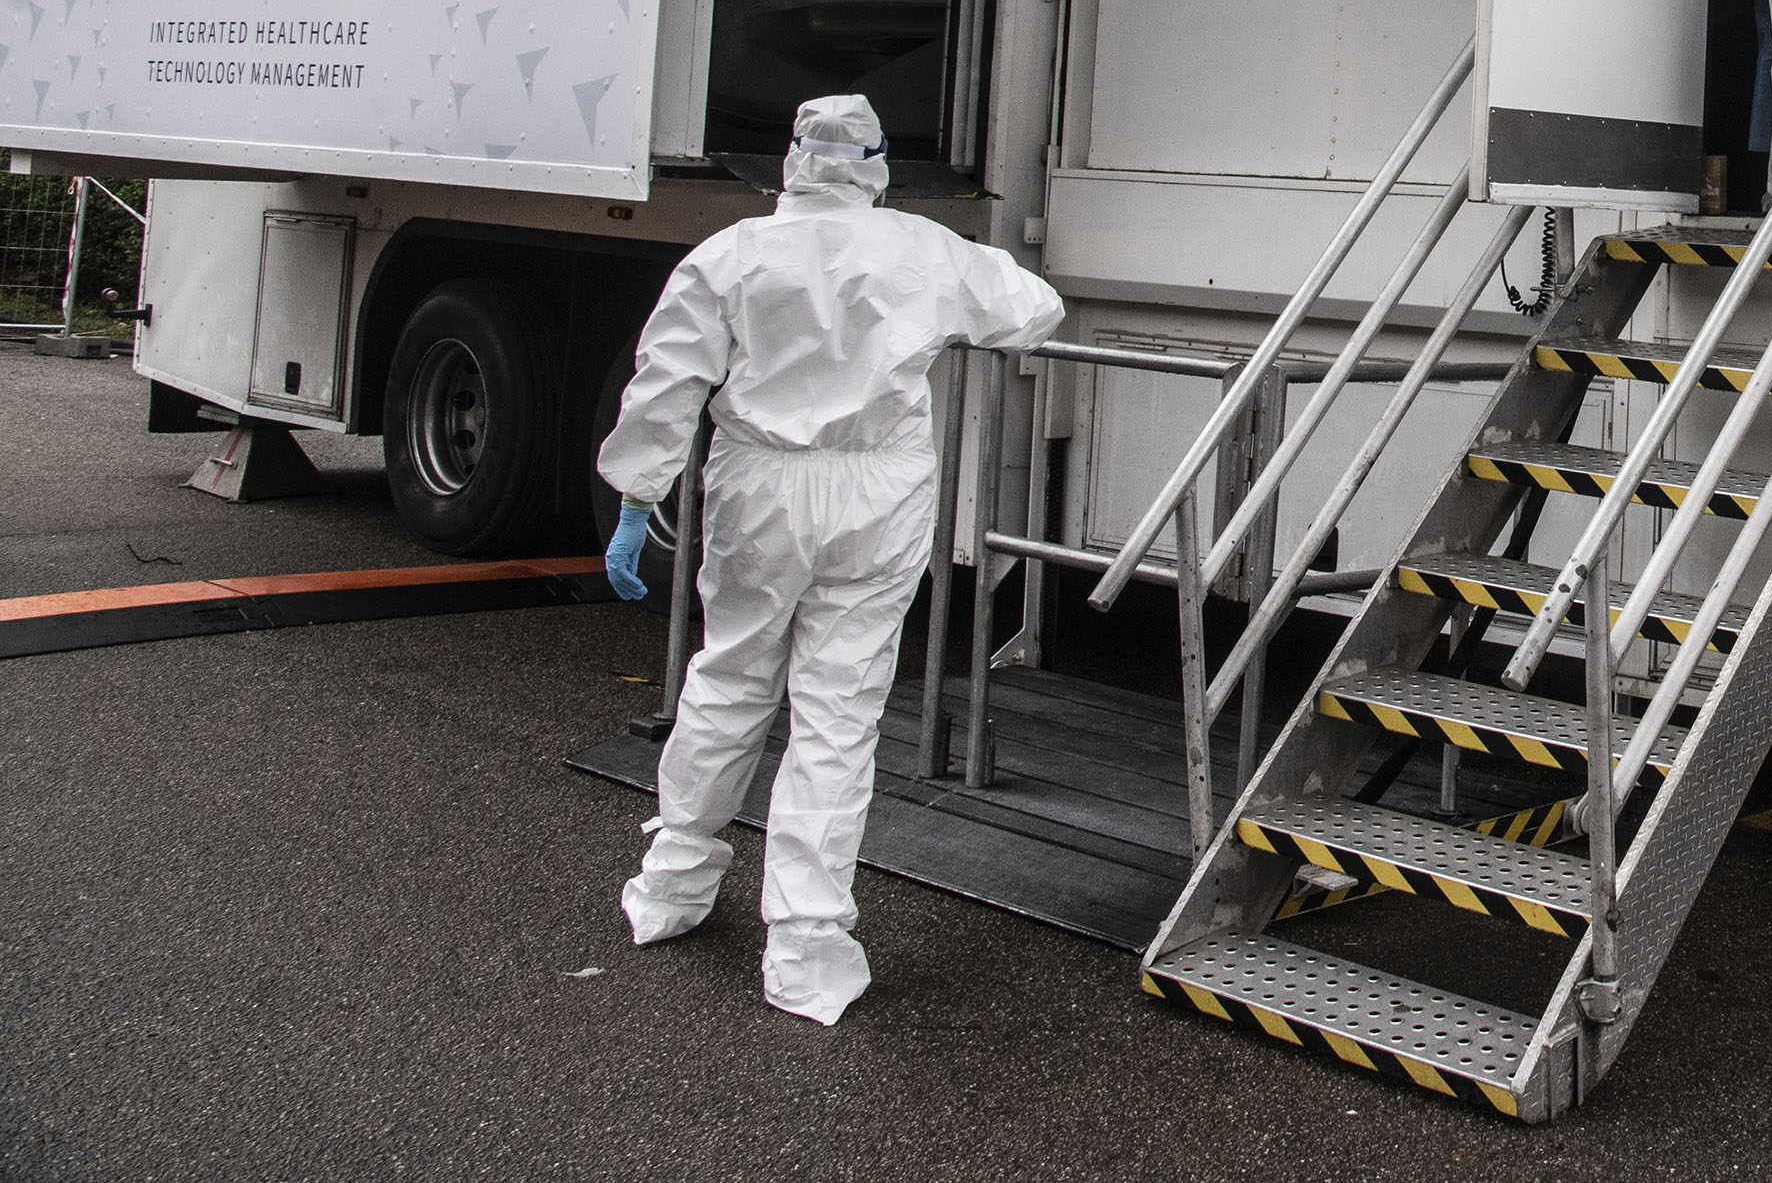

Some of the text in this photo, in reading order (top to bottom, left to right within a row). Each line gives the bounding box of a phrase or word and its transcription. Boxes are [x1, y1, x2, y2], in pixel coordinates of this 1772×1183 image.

[150, 21, 369, 45] INTEGRATED HEALTHCARE
[148, 60, 365, 89] TECHNOLOGY MANAGEMENT
